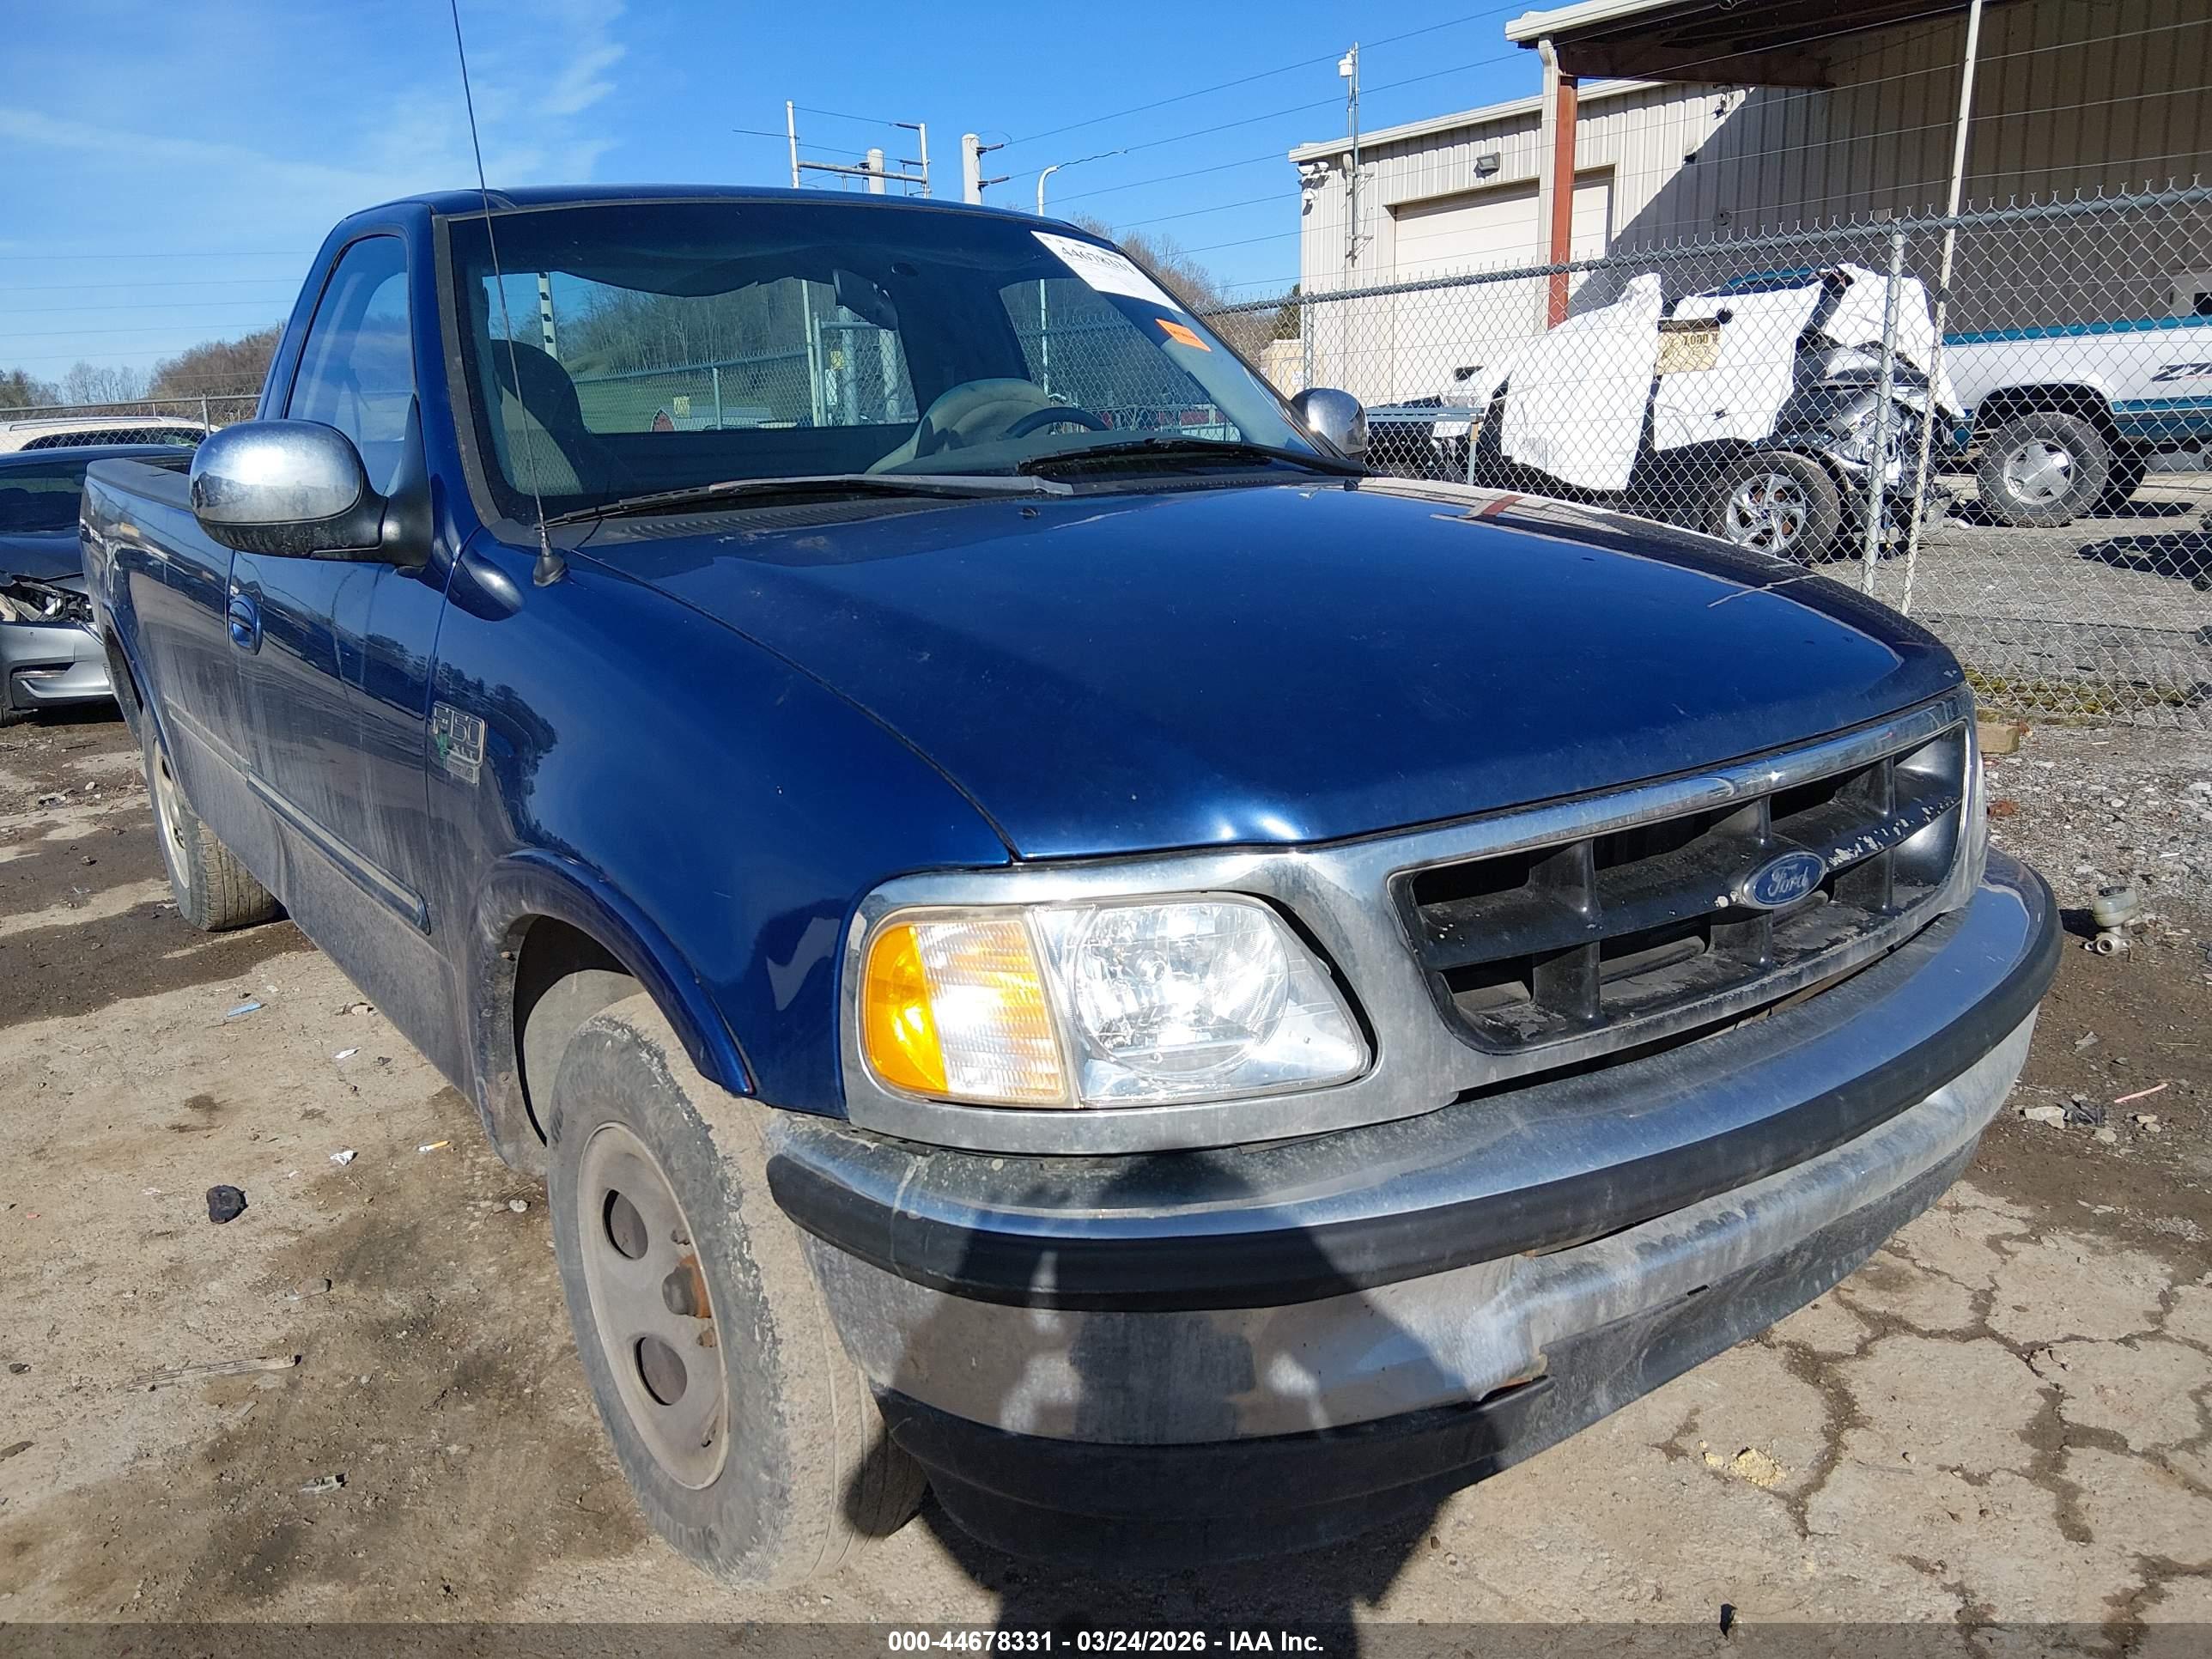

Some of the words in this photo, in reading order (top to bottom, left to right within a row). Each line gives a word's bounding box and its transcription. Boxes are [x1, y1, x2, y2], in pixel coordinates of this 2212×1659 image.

[1061, 246, 1135, 275] 44678331
[452, 742, 476, 761] XLT
[1767, 862, 1809, 897] Ford
